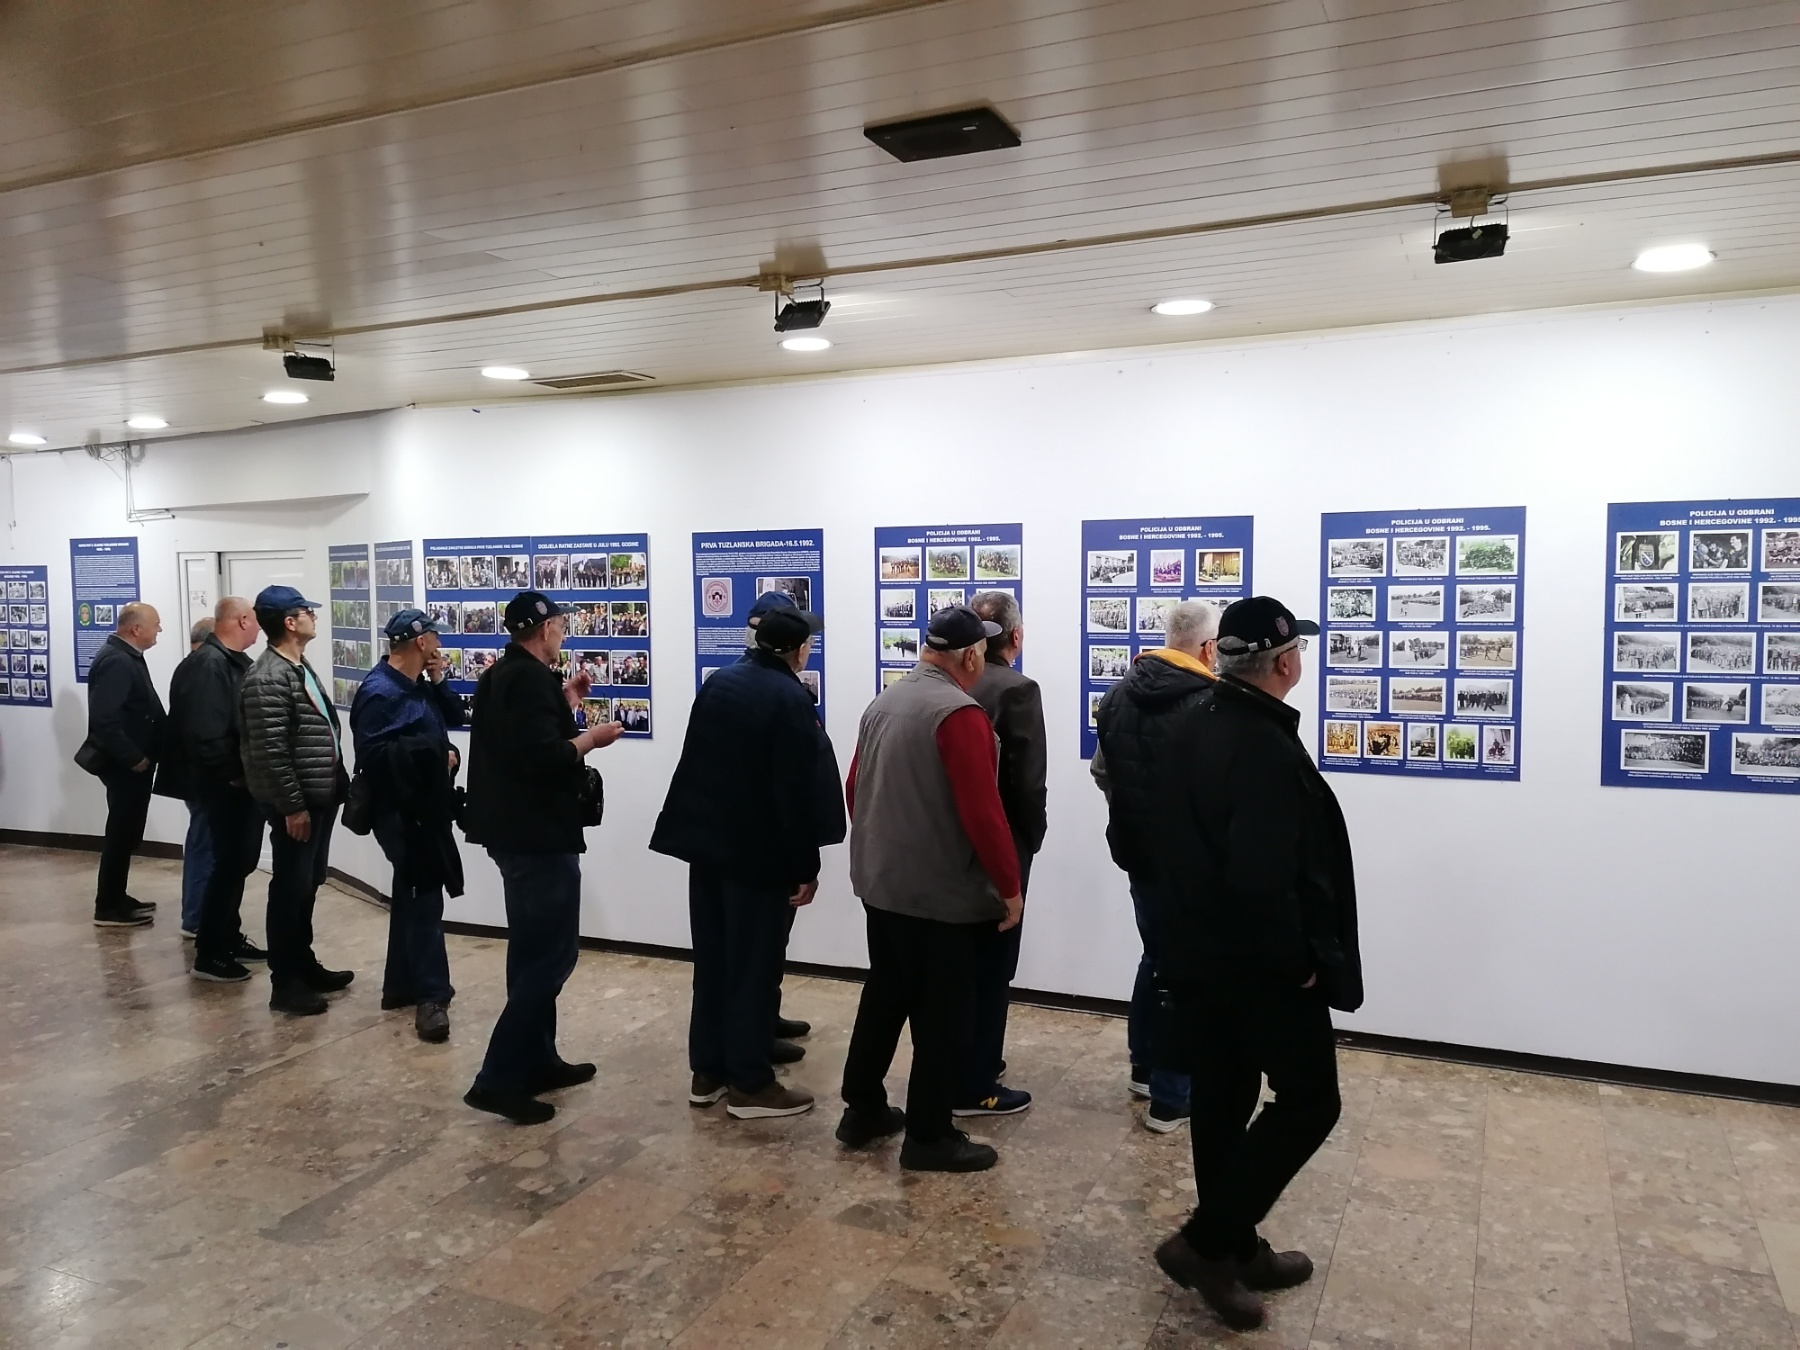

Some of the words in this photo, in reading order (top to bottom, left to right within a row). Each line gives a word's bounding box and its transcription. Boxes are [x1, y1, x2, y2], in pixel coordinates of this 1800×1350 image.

[1689, 510, 1727, 518] POLICIJA
[1728, 509, 1735, 517] U
[1736, 508, 1775, 516] ODBRANI
[1391, 518, 1423, 526] POLICIJA
[1431, 517, 1465, 525] ODBRANI
[1694, 517, 1752, 525] HERCEGOVINE
[1365, 527, 1390, 535] BOSNE
[718, 541, 755, 549] TUZLANSKA
